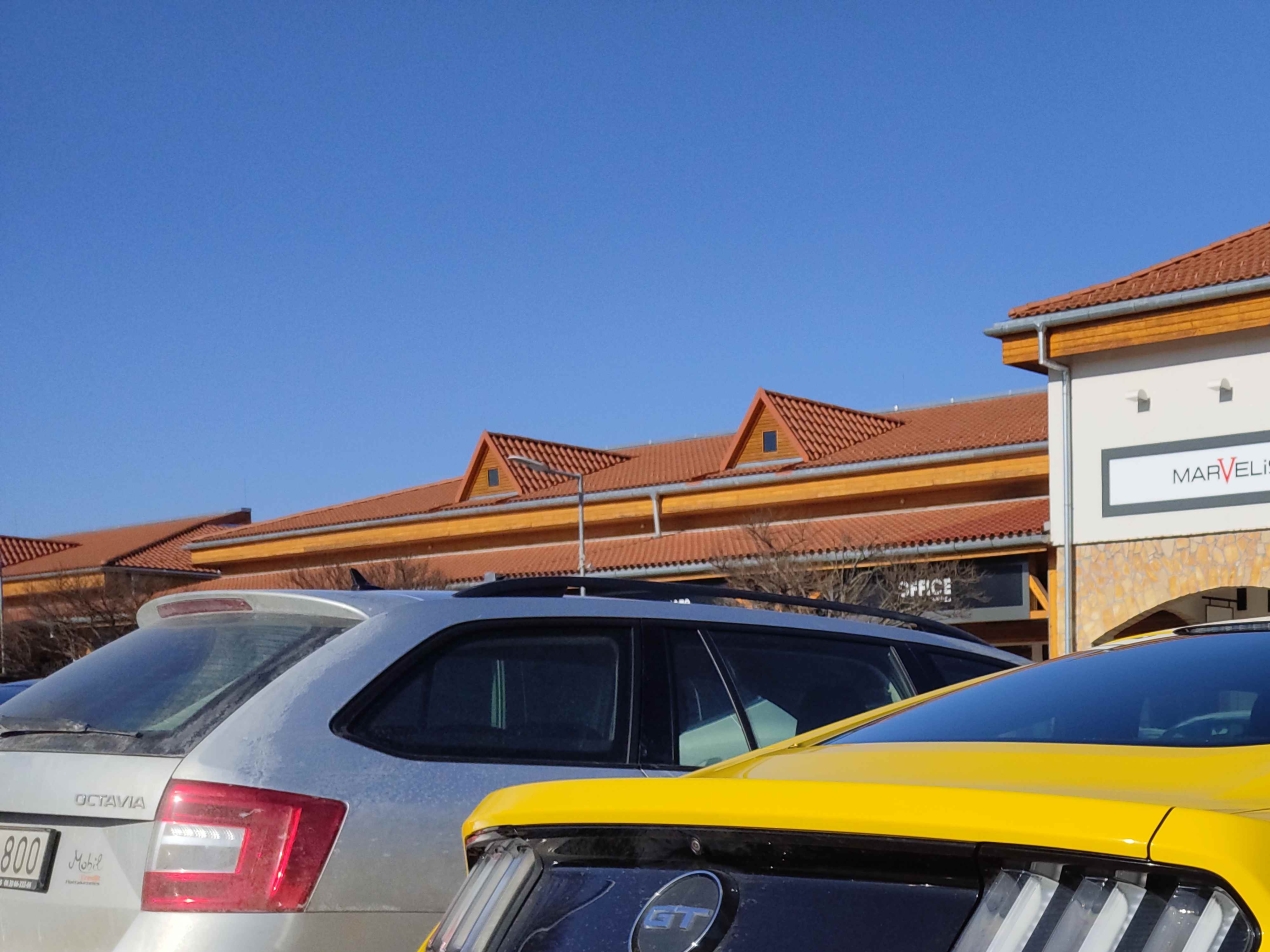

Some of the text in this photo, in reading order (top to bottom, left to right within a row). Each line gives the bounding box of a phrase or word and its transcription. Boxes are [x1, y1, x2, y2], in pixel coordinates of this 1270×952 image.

[898, 577, 952, 598] OFFICE
[75, 793, 146, 809] OCTAVIA
[643, 904, 714, 931] GT
